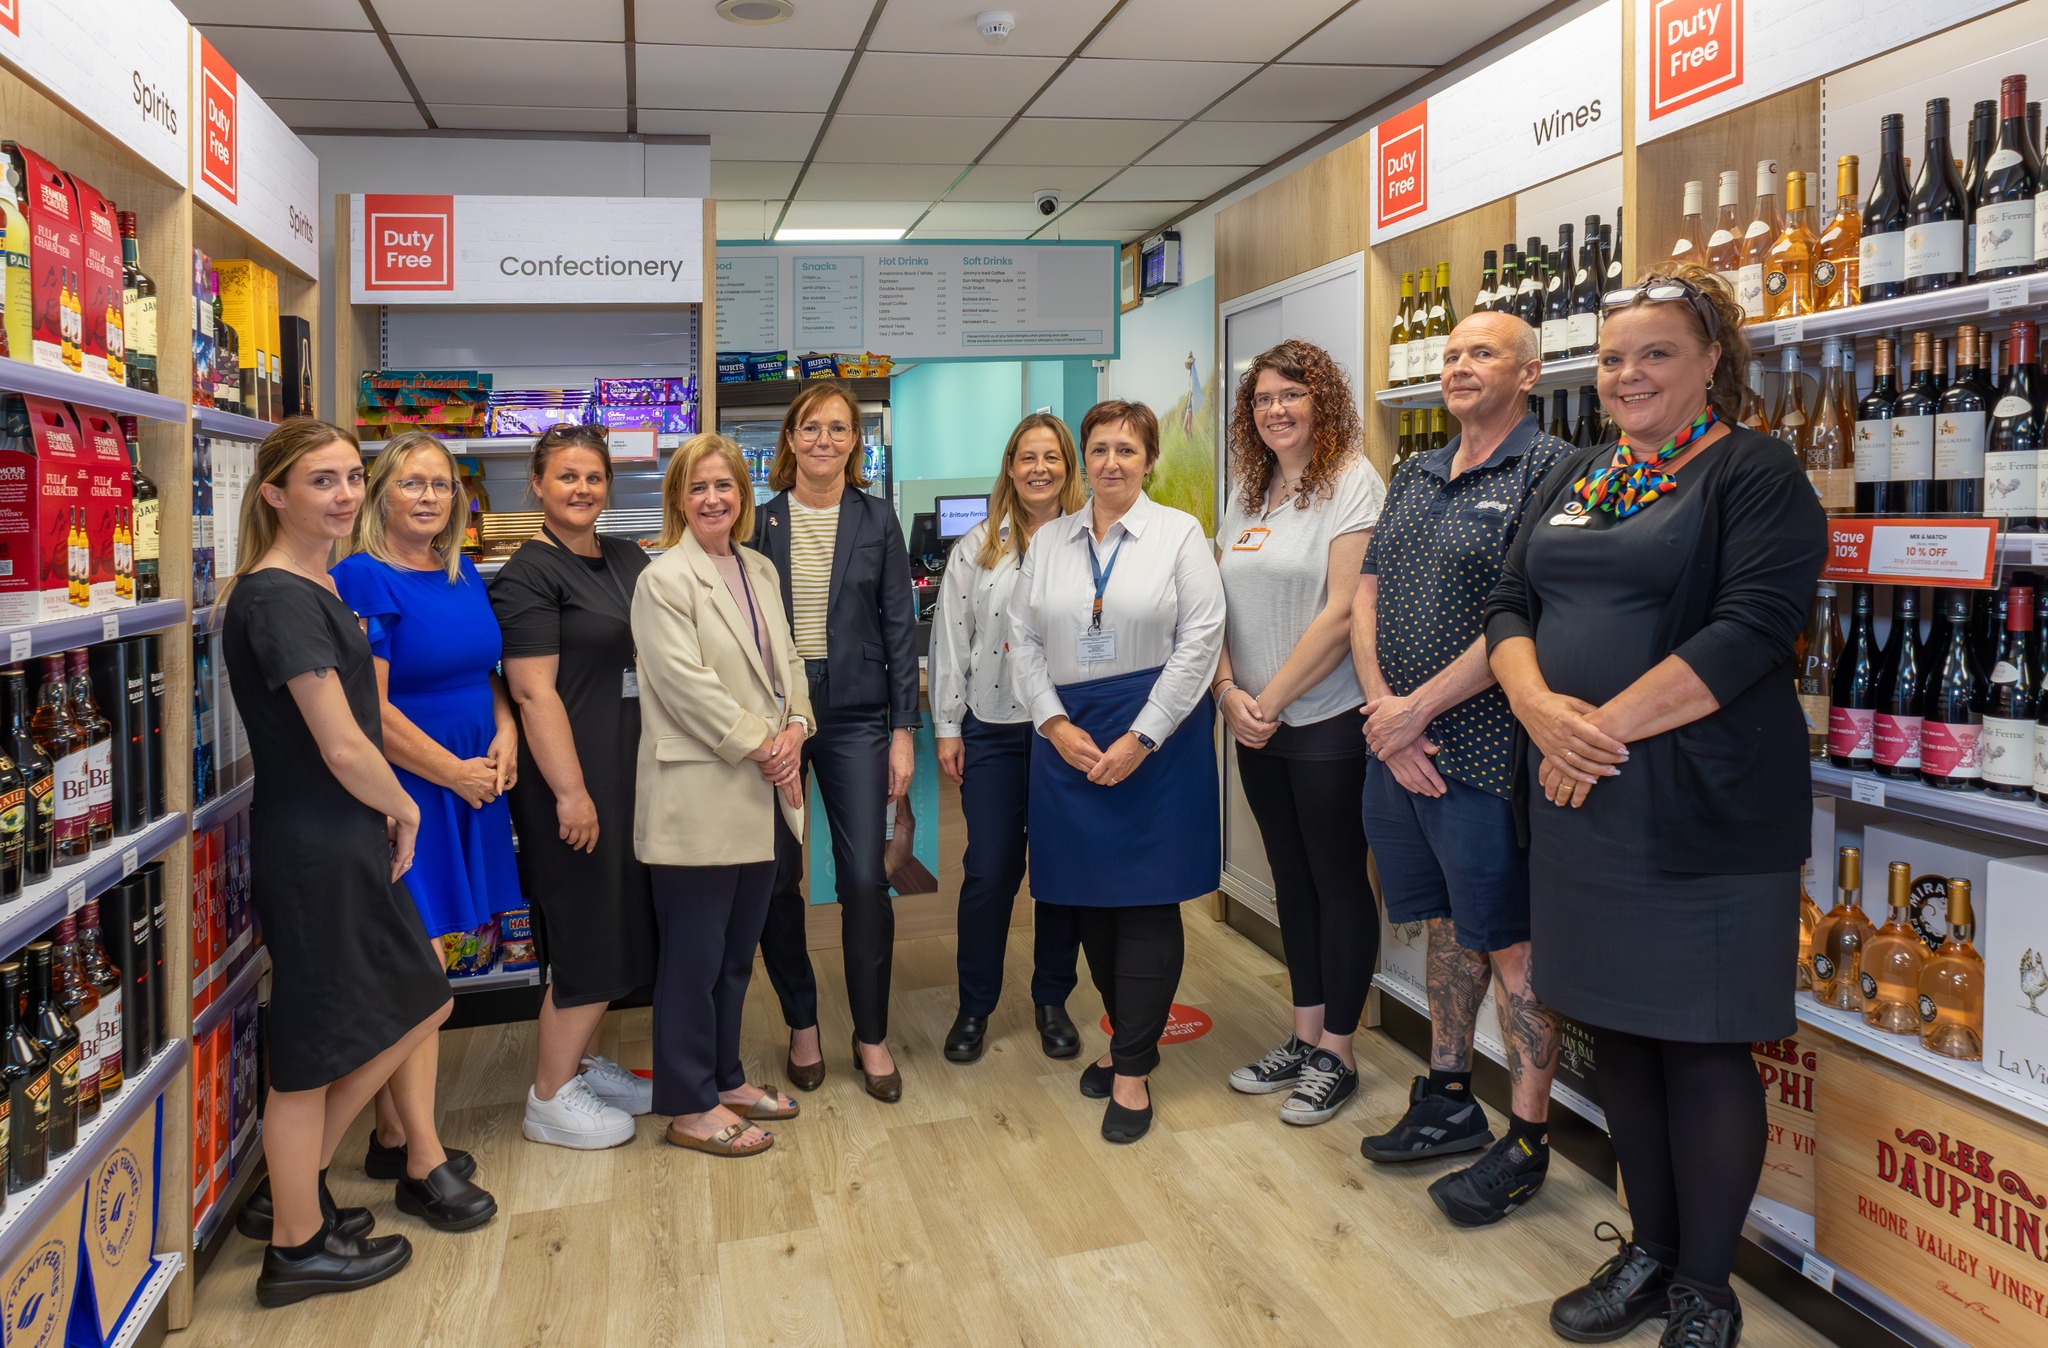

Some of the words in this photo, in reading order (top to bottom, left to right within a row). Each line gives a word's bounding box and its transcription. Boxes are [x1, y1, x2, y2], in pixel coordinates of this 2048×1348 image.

[1667, 2, 1722, 47] Duty
[1670, 39, 1720, 78] Free
[132, 70, 178, 136] Spirits
[208, 97, 231, 141] Duty
[1532, 98, 1602, 146] Wines
[210, 131, 230, 166] Free
[1387, 148, 1417, 177] Duty
[1388, 176, 1415, 200] Free
[2002, 211, 2032, 222] Ferme
[289, 204, 314, 245] Spirits
[34, 235, 71, 260] CHARACTER
[384, 230, 435, 252] Duty
[386, 252, 432, 268] Free
[802, 262, 837, 271] Snacks
[879, 257, 897, 266] Hot
[898, 256, 929, 266] Drinks
[962, 256, 982, 266] Soft
[983, 256, 1013, 266] Drinks
[86, 258, 115, 279] CHARACTER
[500, 255, 684, 283] Confectionery
[719, 363, 745, 372] BURTS
[757, 361, 783, 370] BURTS
[807, 358, 831, 368] BURTS
[368, 377, 470, 391] TOBLERONE
[389, 414, 420, 424] LOVE
[423, 414, 447, 423] YOU
[501, 415, 527, 424] DAIRY
[501, 422, 522, 430] MILK
[46, 473, 61, 485] FULL
[93, 475, 108, 486] FULL
[42, 483, 79, 497] CHARACTER
[91, 485, 122, 497] CHARACTER
[949, 511, 970, 519] Brittany
[1832, 530, 1865, 544] Save
[1835, 544, 1859, 558] 10%
[1906, 546, 1914, 556] 10
[1918, 547, 1927, 557] %
[1928, 547, 1948, 557] OFF
[1893, 557, 1904, 565] Any
[1910, 557, 1932, 566] bottles
[1932, 558, 1939, 566] of
[1995, 727, 2025, 739] Ferme
[1385, 959, 1393, 973] La
[1393, 963, 1410, 984] Vieille
[1170, 1026, 1196, 1036] sail
[1998, 1049, 2020, 1075] La
[1938, 1132, 1994, 1184] LES
[1857, 1194, 1908, 1241] RHONE
[1915, 1220, 1979, 1278] VALLEY
